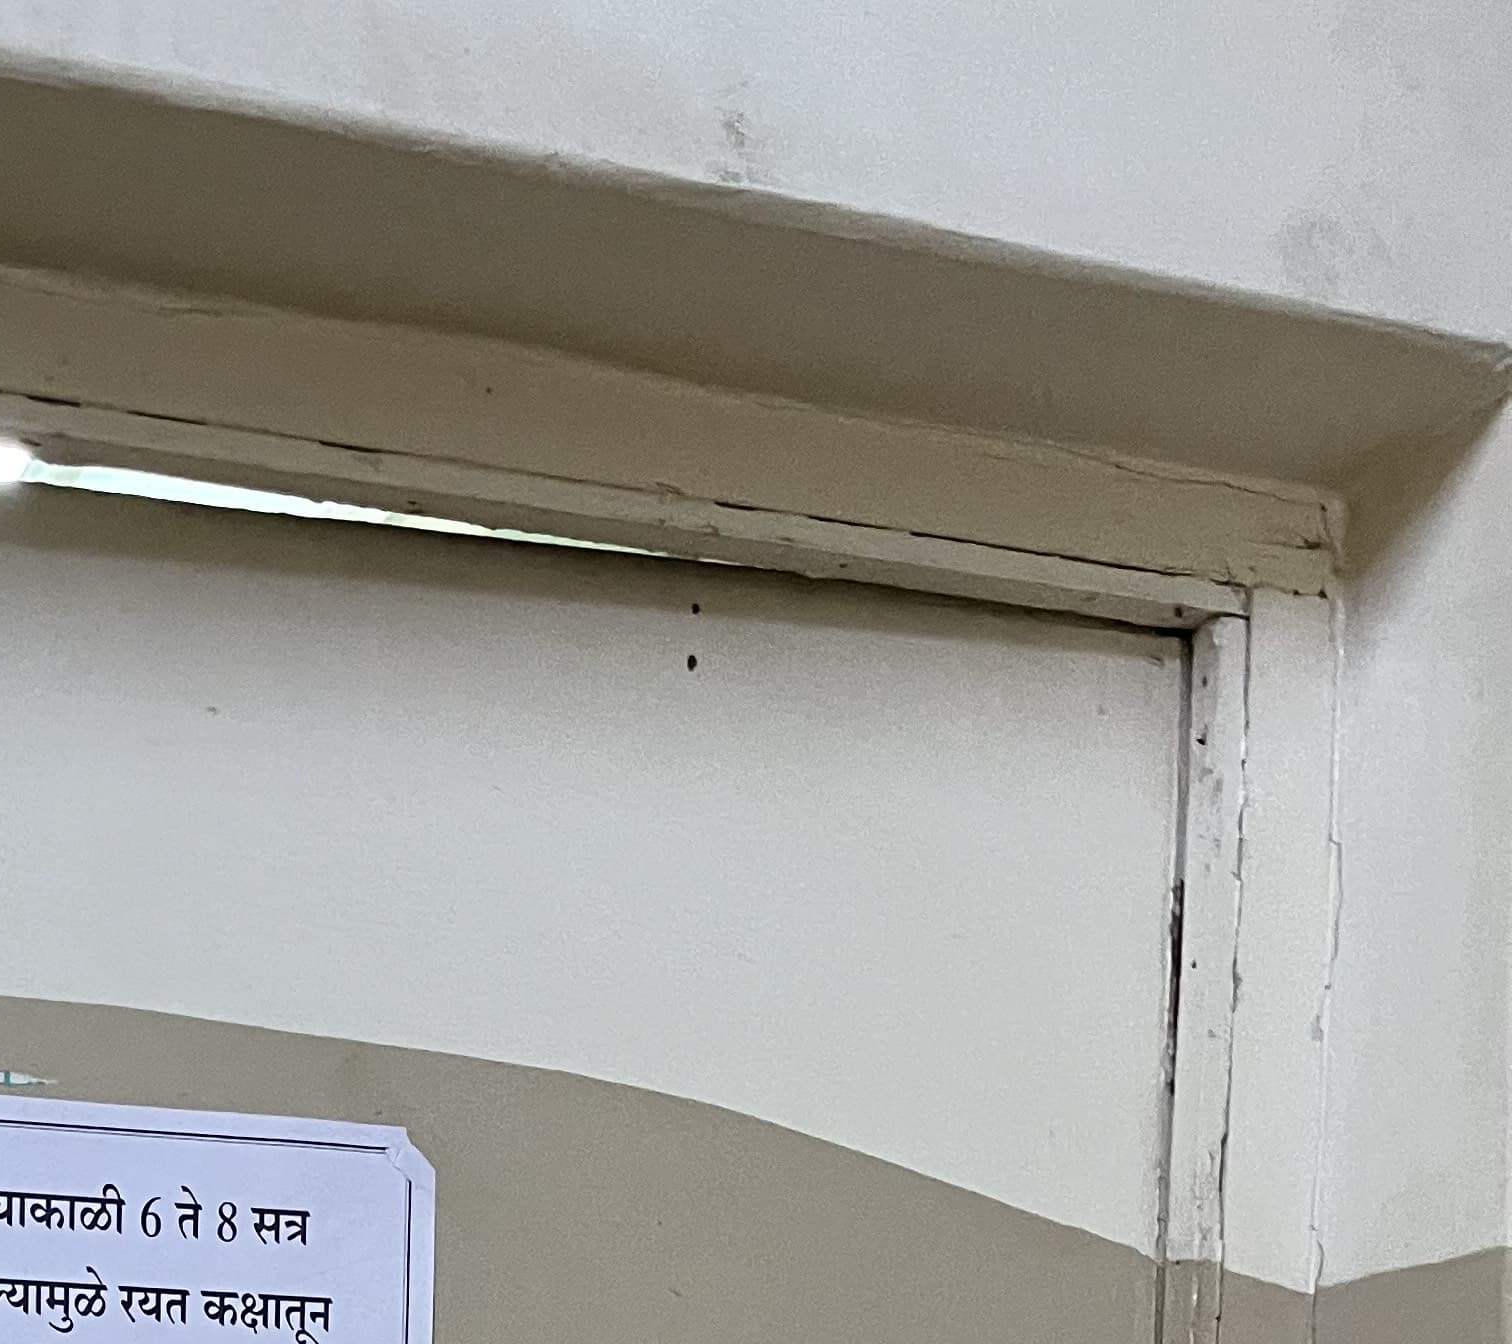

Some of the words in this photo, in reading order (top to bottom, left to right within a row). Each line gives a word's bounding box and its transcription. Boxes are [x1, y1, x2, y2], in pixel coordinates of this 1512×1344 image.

[140, 1196, 162, 1238] 6
[174, 1185, 203, 1240] ते
[217, 1201, 238, 1243] 8
[250, 1207, 311, 1246] सत्र
[117, 1285, 191, 1325] रयत
